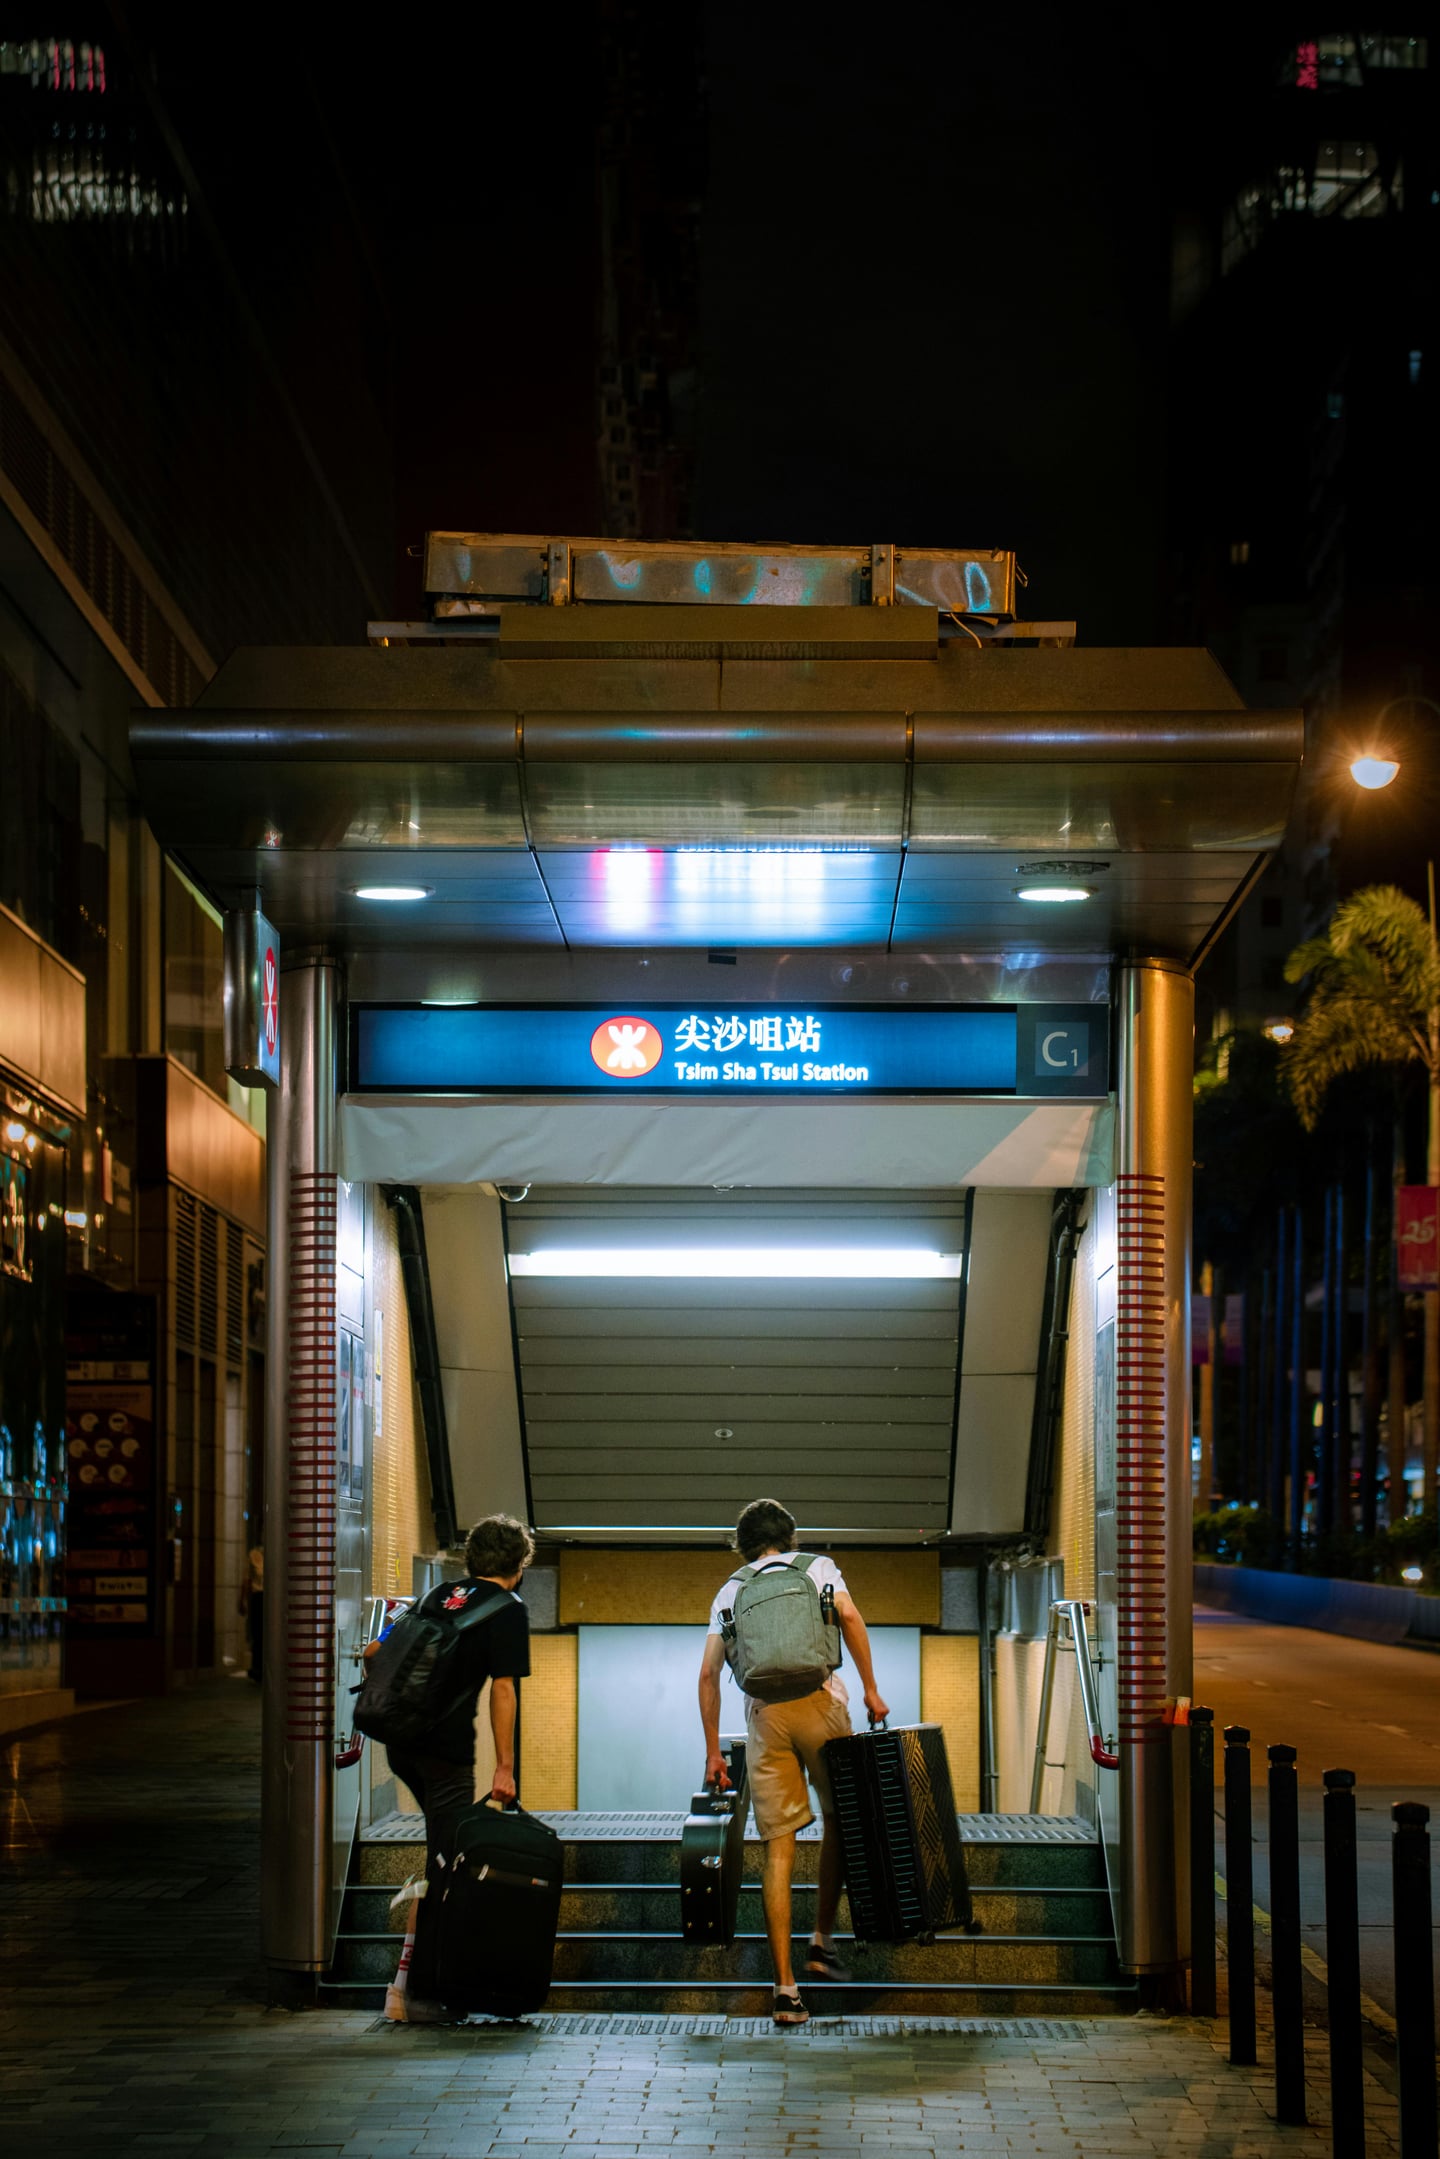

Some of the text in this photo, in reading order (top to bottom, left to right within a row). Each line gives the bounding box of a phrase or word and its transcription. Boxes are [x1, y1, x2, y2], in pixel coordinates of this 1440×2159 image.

[674, 1015, 822, 1052] 尖沙咀站
[674, 1062, 869, 1080] Tsim Sha Tsui Station
[1401, 1215, 1437, 1245] 25
